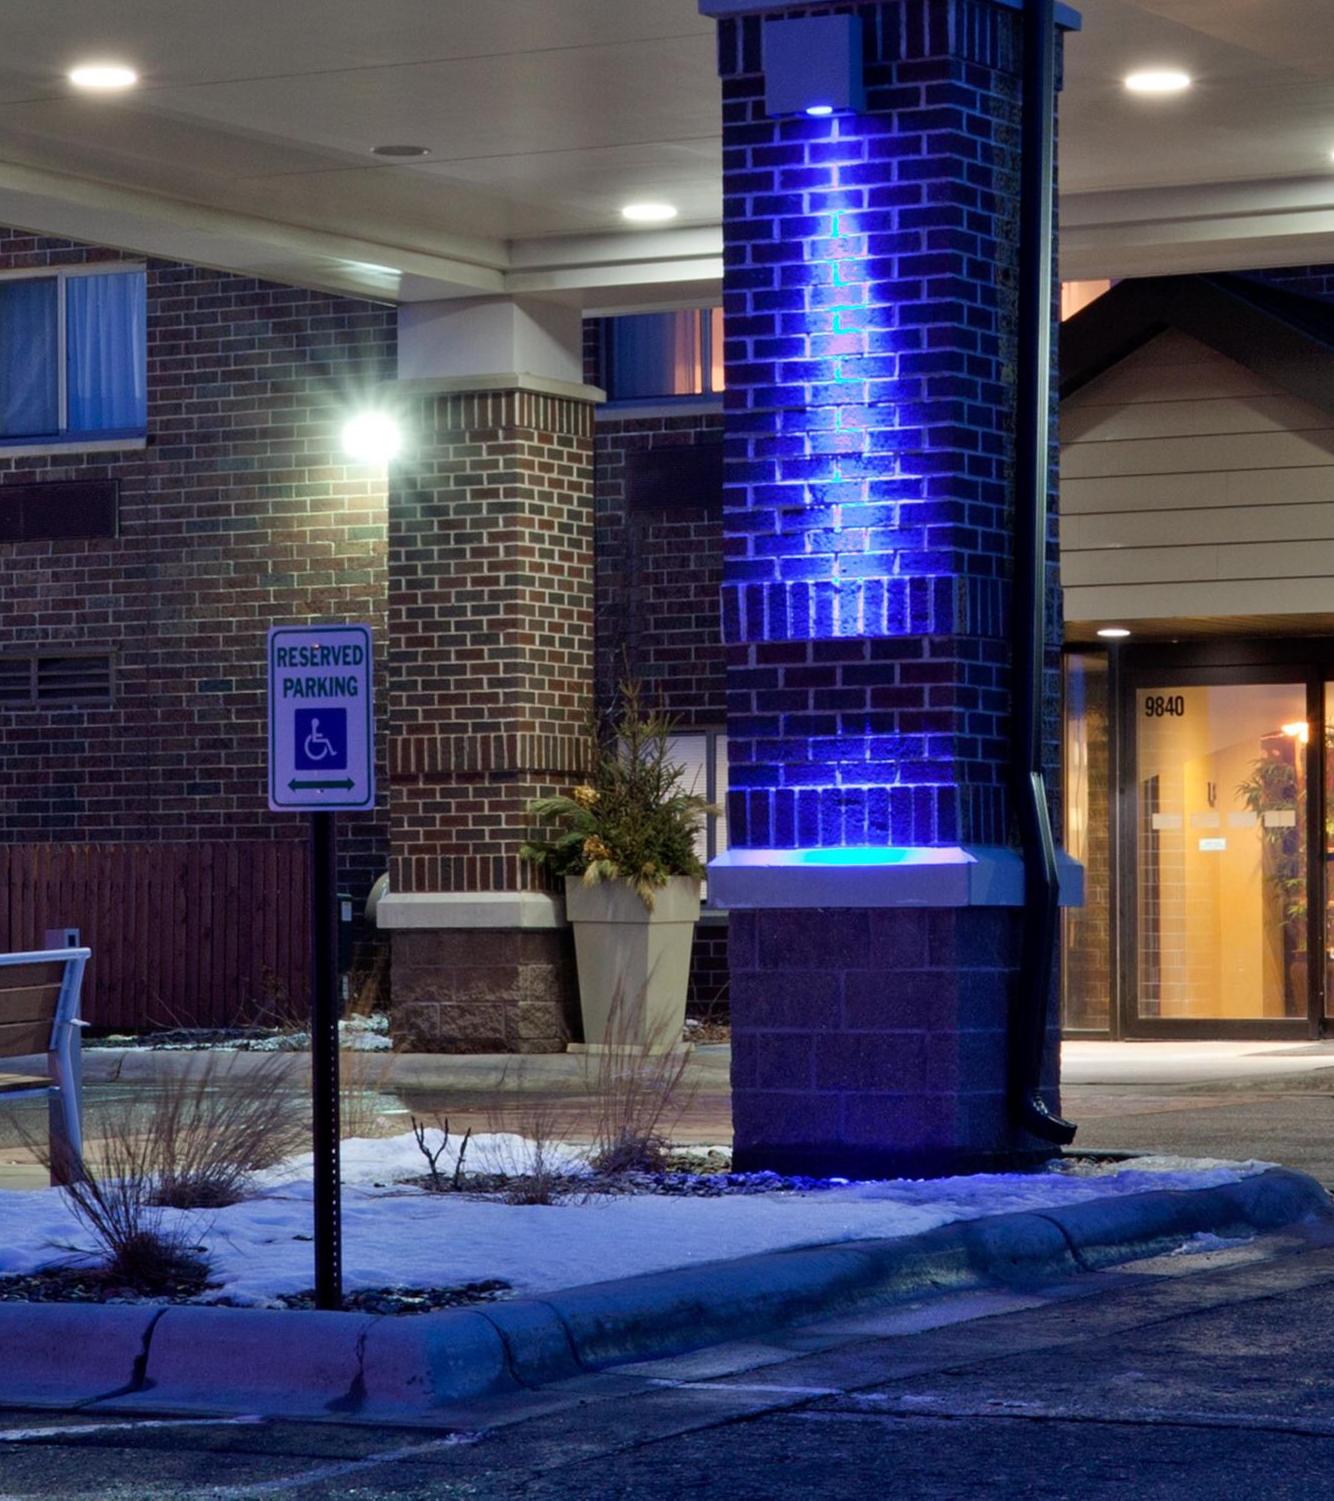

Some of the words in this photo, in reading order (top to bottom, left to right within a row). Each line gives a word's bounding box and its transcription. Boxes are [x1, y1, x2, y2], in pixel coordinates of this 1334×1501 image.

[277, 645, 364, 668] RESERVED
[283, 675, 359, 698] PARKING
[1145, 695, 1184, 717] 9840
